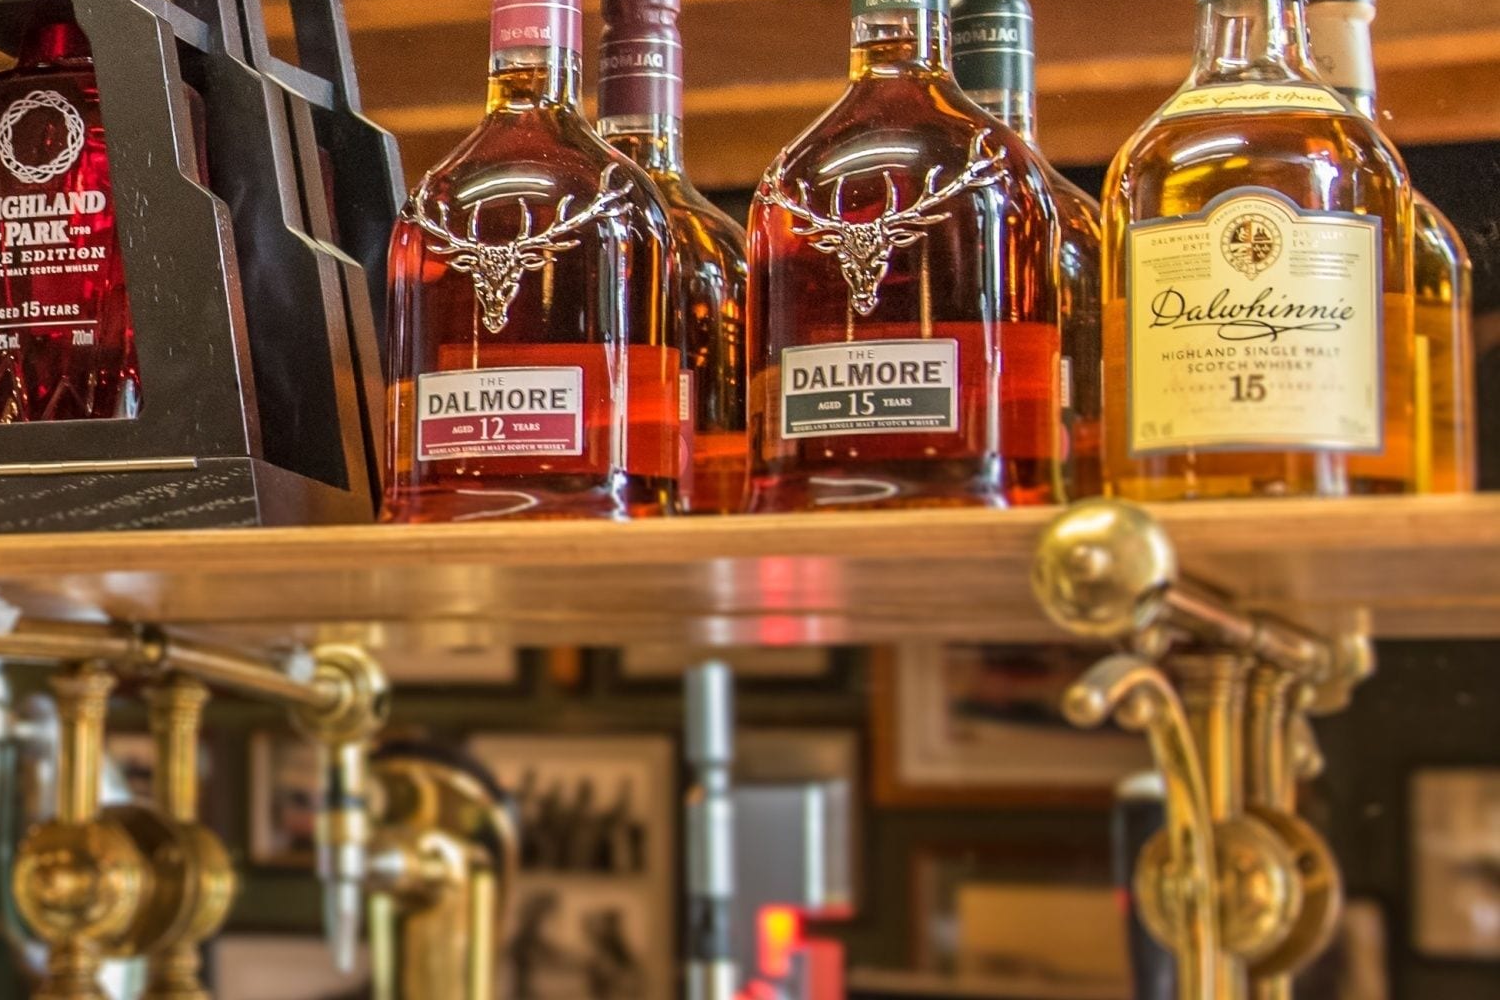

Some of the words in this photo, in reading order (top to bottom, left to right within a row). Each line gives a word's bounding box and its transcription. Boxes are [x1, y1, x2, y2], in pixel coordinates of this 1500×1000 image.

[4, 219, 70, 247] PARK
[69, 226, 92, 236] 1798
[21, 247, 106, 263] EDITION
[6, 267, 28, 277] MALT
[30, 265, 63, 275] SCOTCH
[65, 264, 99, 274] WHISKY
[22, 301, 41, 318] 15
[42, 304, 80, 316] YEARS
[1149, 286, 1355, 330] Dalwhinnie
[848, 349, 877, 360] THE
[1161, 346, 1238, 362] HIGHLAND
[1244, 346, 1298, 357] SINGLE
[1305, 346, 1341, 358] MALT
[1187, 360, 1248, 374] SCOTCH
[1254, 359, 1314, 372] WHISKY
[480, 376, 506, 387] THE
[792, 360, 942, 391] DALMORE
[1228, 373, 1267, 403] 15
[428, 388, 568, 415] DALMORE
[817, 400, 842, 410] AGED
[848, 391, 876, 416] 15
[881, 397, 913, 408] YEARS
[452, 424, 475, 434] AGED
[480, 416, 507, 440] 12
[512, 422, 541, 432] YEARS
[856, 420, 876, 428] MALT
[878, 419, 908, 427] SCOTCH
[909, 418, 940, 426] WHISKY
[487, 443, 506, 451] MALT
[507, 443, 536, 451] SCOTCH
[537, 442, 567, 451] WHISKY
